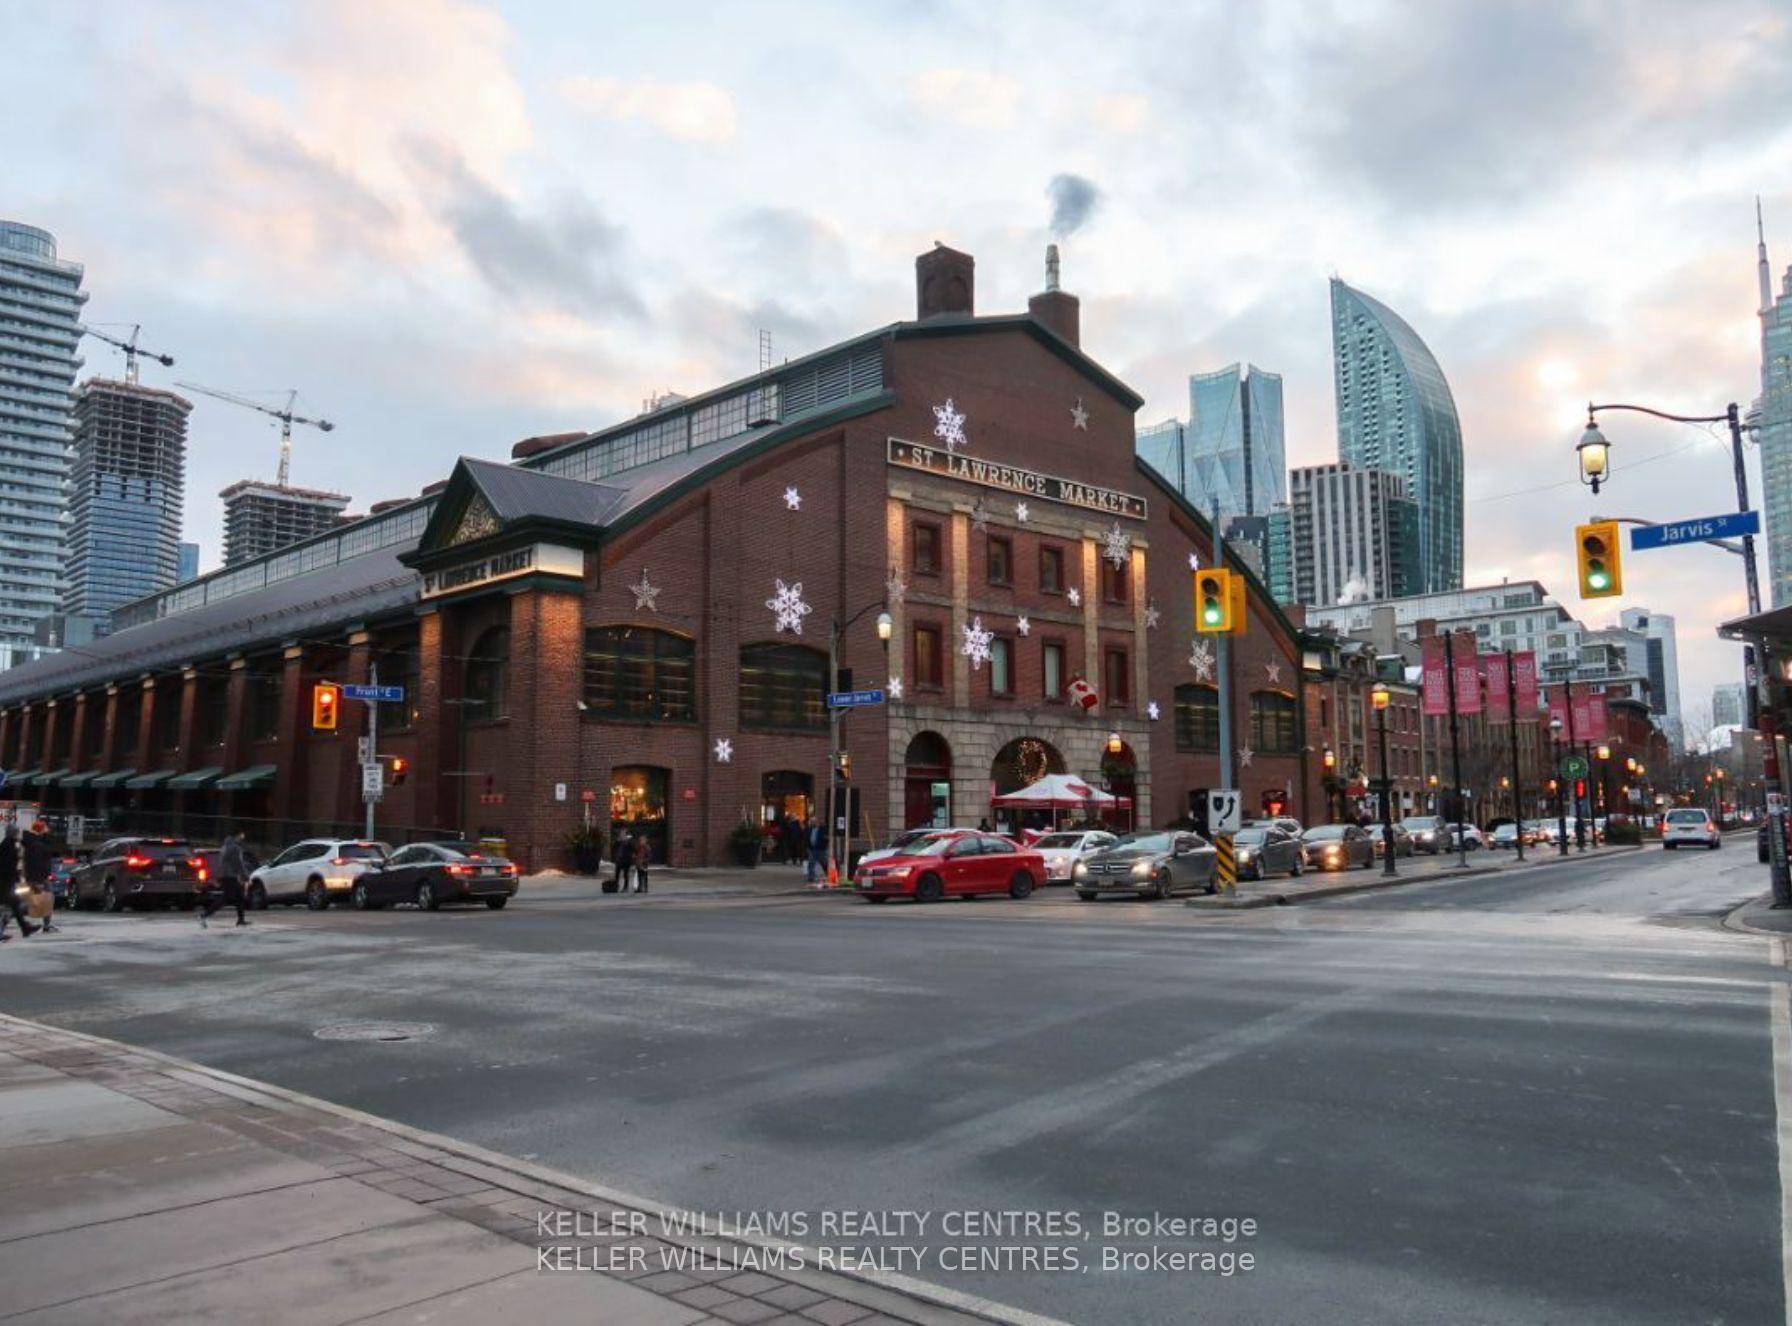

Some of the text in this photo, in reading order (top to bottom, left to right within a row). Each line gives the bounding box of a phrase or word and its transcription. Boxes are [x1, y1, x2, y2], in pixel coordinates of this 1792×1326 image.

[911, 447, 1130, 512] ST LAWRENCE MARKET
[1661, 521, 1714, 541] Jarvis
